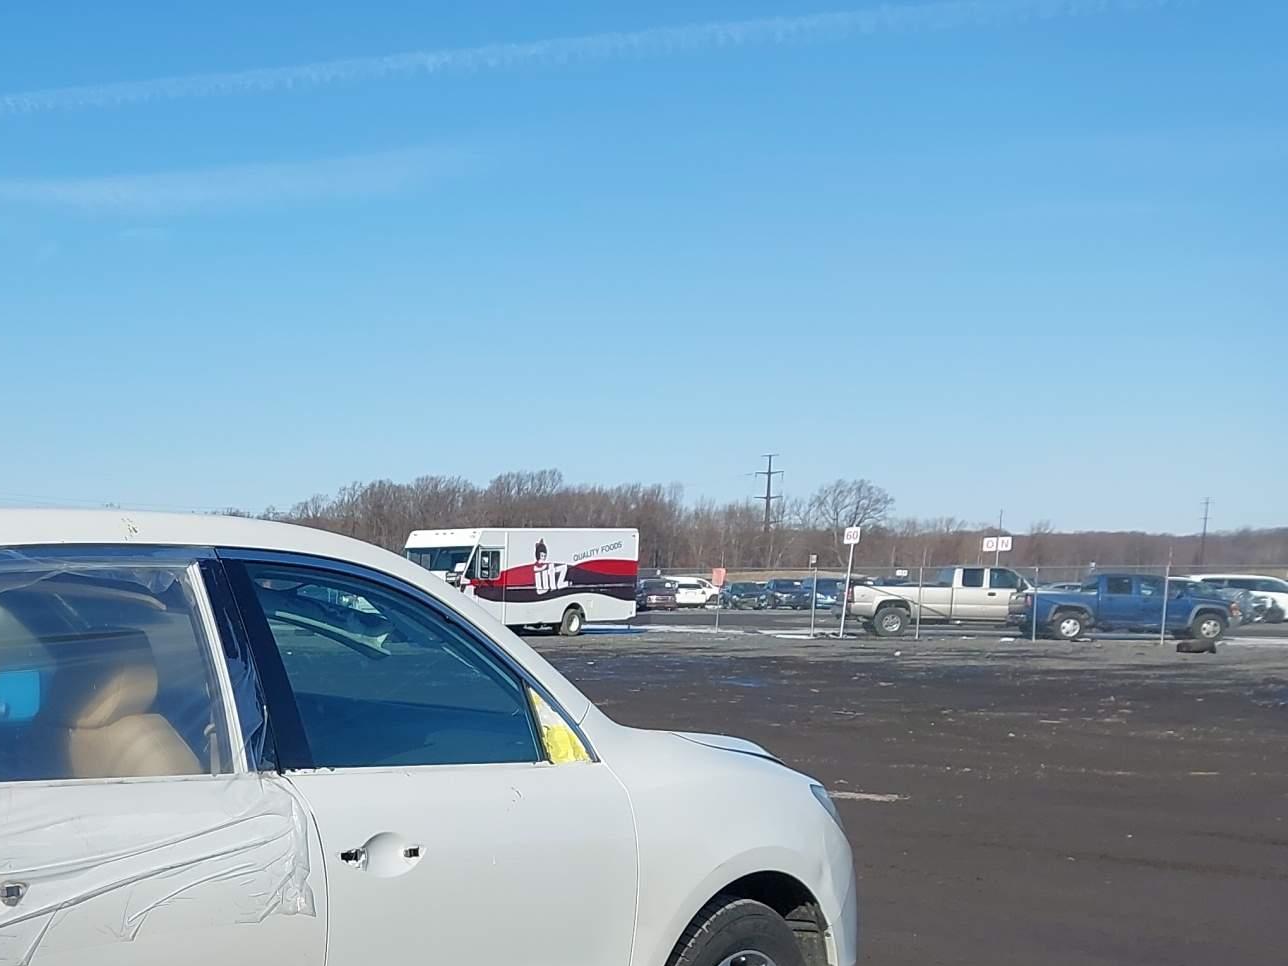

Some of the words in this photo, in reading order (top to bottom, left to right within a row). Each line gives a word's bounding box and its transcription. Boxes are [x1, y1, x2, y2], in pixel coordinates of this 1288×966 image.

[573, 547, 600, 561] QUALITY
[601, 541, 623, 553] FOODS
[1001, 539, 1010, 549] N
